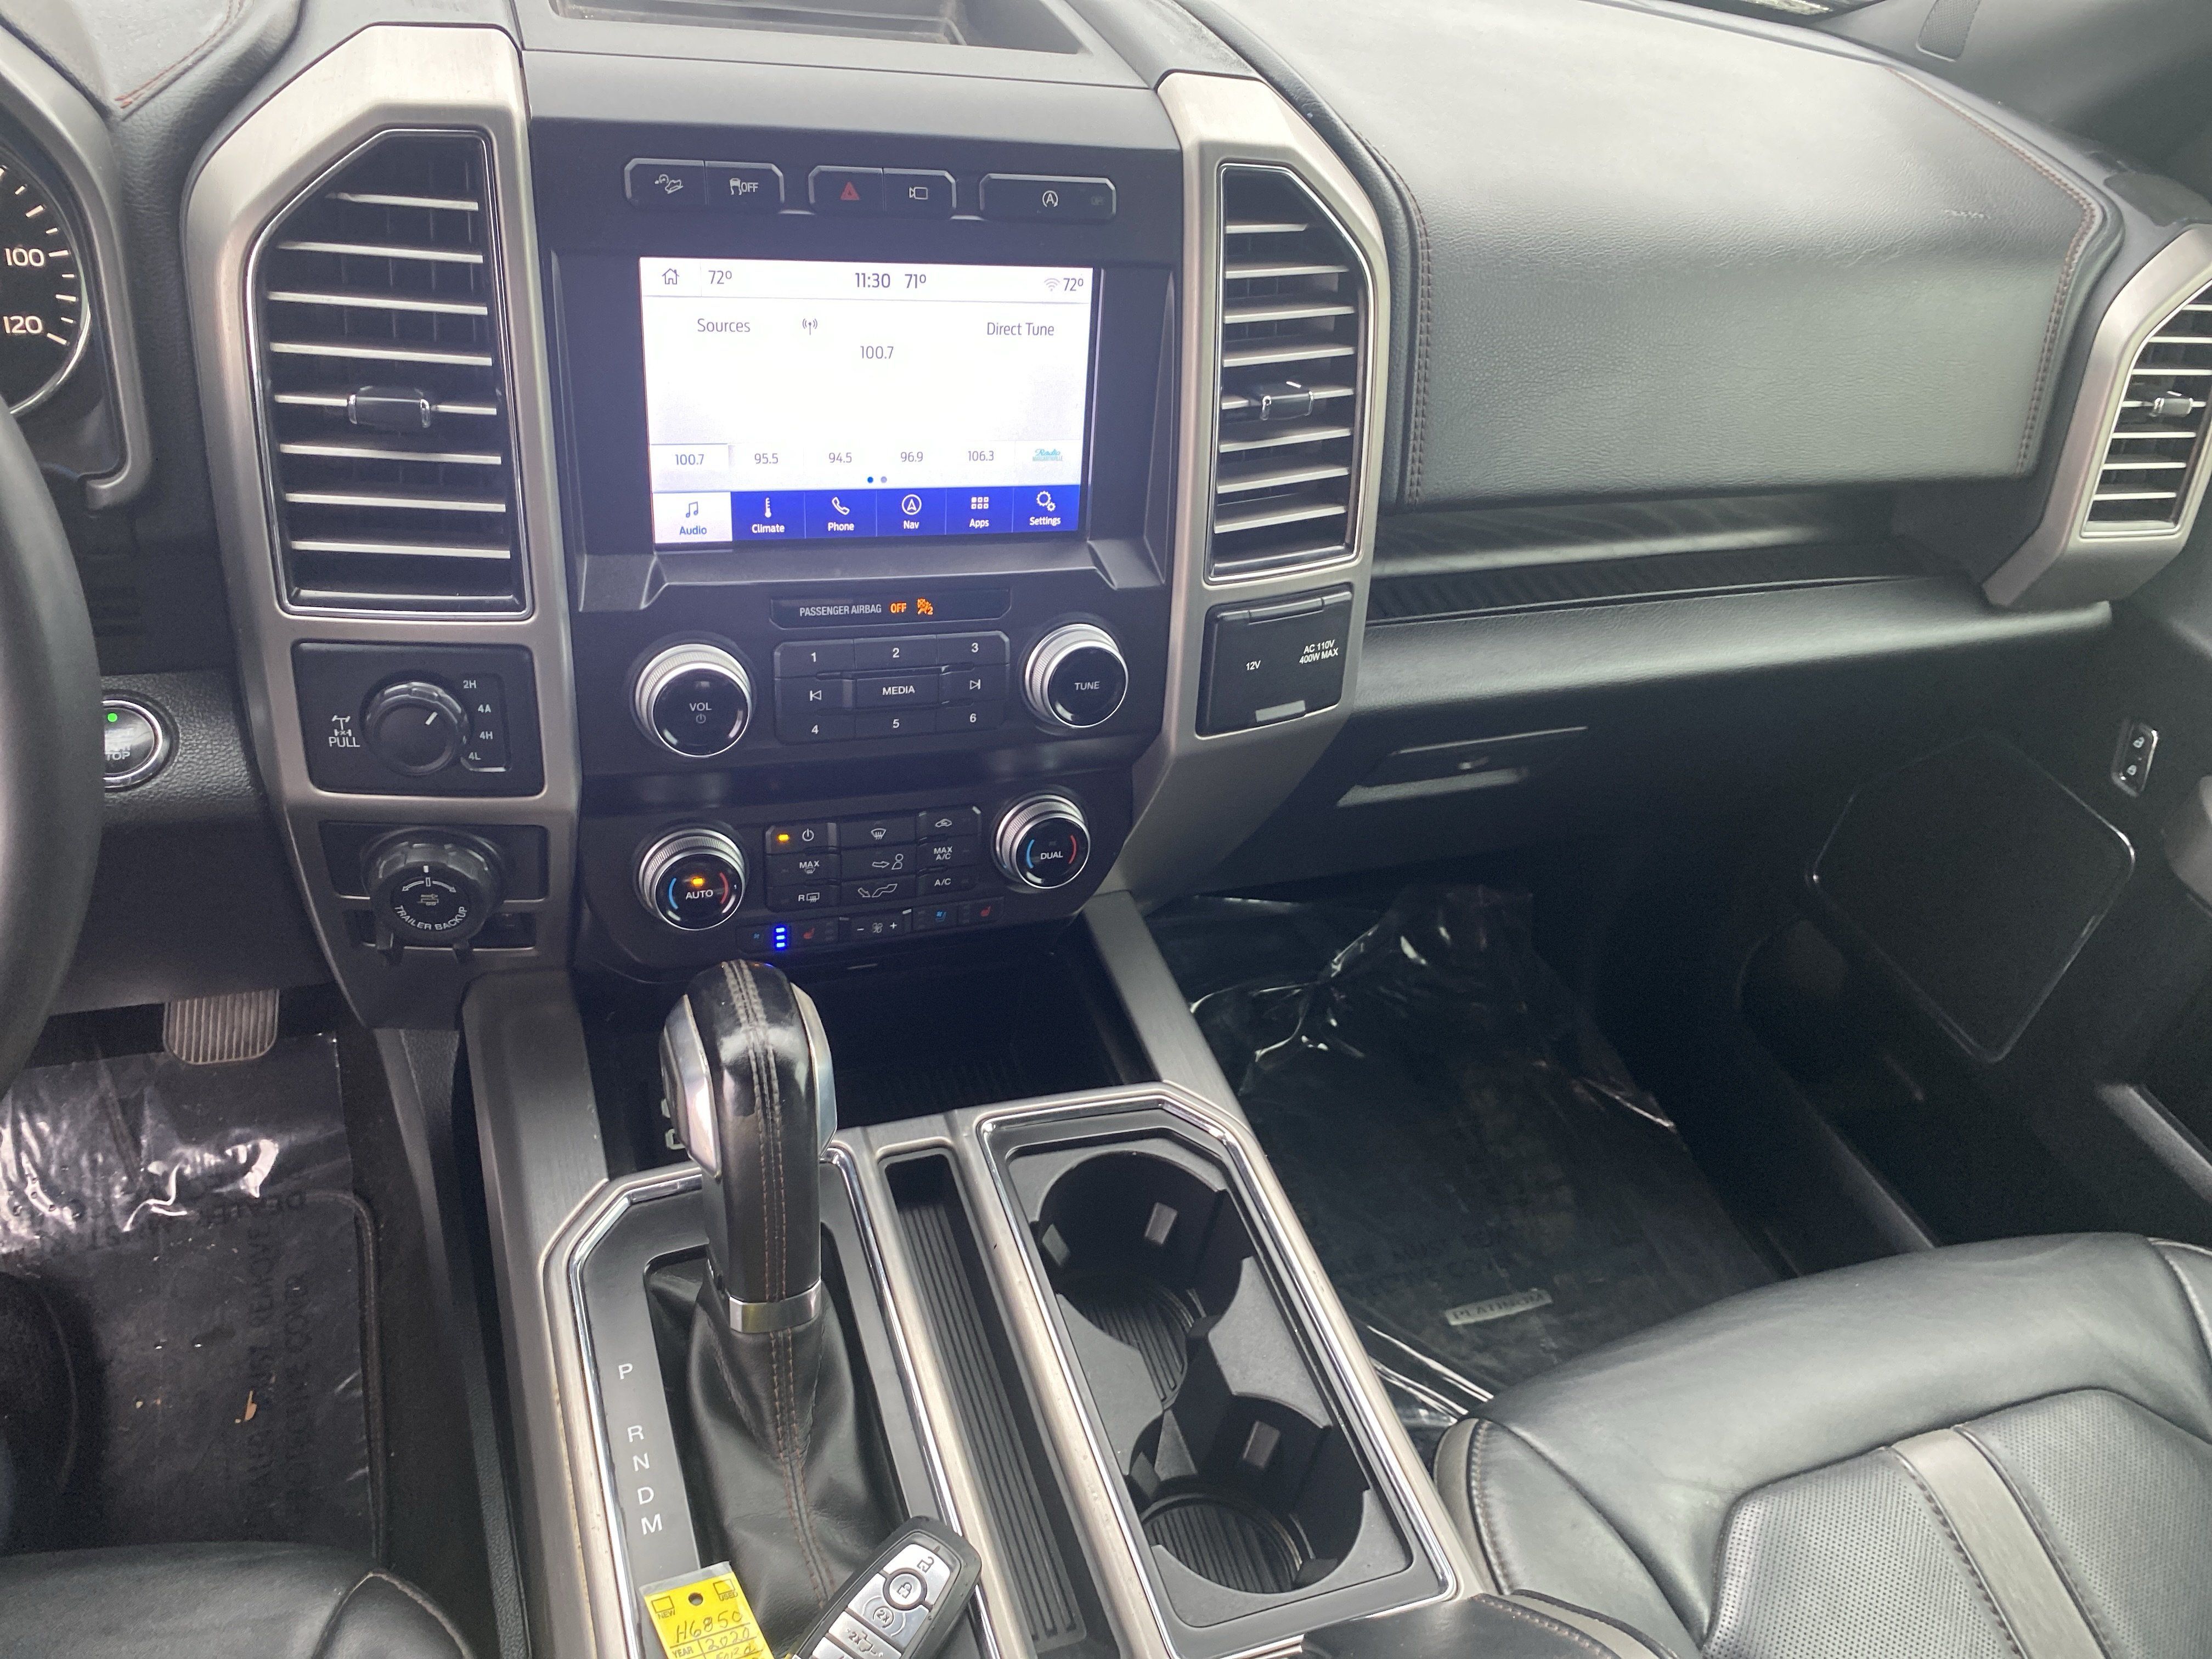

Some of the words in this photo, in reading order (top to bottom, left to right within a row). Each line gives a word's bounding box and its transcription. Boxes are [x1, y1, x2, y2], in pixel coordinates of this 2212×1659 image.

[741, 181, 759, 194] OFF
[5, 248, 45, 267] 100
[855, 272, 890, 289] 11:30
[3, 315, 43, 335] 120
[697, 318, 751, 332] Sources
[987, 322, 1023, 336] Direct
[1025, 322, 1054, 336] Tune
[860, 346, 894, 359] 100.7
[675, 454, 704, 466] 100.7
[754, 453, 778, 465] 95.5
[828, 452, 852, 464] 94.5
[900, 451, 923, 462] 96.9
[968, 450, 994, 461] 106.3
[827, 522, 855, 532] Phone
[903, 520, 920, 529] Nav
[969, 518, 989, 529] Apps
[1029, 516, 1061, 527] Settings
[679, 525, 707, 535] Audio
[752, 523, 785, 534] Climate
[799, 605, 850, 617] PASSENGER
[850, 603, 882, 614] AIRBAG
[890, 602, 907, 614] OFF
[971, 642, 979, 653] 3
[1303, 644, 1316, 654] AC
[1317, 639, 1336, 652] 110V
[811, 652, 816, 663] 1
[892, 647, 900, 658] 2
[1299, 651, 1321, 664] 400W
[1321, 646, 1339, 659] MAX
[1246, 660, 1261, 671] 12V
[462, 680, 477, 689] 2H
[1074, 680, 1100, 691] TUNE
[882, 685, 916, 696] MEDIA
[477, 704, 492, 713] 4A
[689, 702, 712, 712] VOL
[969, 713, 977, 723] 6
[811, 724, 819, 735] 4
[891, 719, 900, 729] 5
[479, 731, 493, 740] 4H
[328, 736, 360, 748] PULL
[468, 752, 481, 760] 4L
[933, 845, 953, 855] MAX
[1040, 850, 1064, 860] DUAL
[935, 853, 951, 861] A/C
[799, 860, 820, 869] MAX
[934, 878, 951, 887] A/C
[685, 889, 714, 900] AUTO
[394, 905, 432, 930] TRAILER
[435, 906, 467, 930] BACKUP
[618, 1363, 633, 1380] P
[627, 1425, 645, 1443] R
[633, 1452, 650, 1472] N
[637, 1486, 654, 1505] D
[641, 1513, 663, 1536] M
[718, 1591, 739, 1602] USED
[658, 1609, 676, 1620] NEW
[672, 1646, 695, 1659] YEAR
